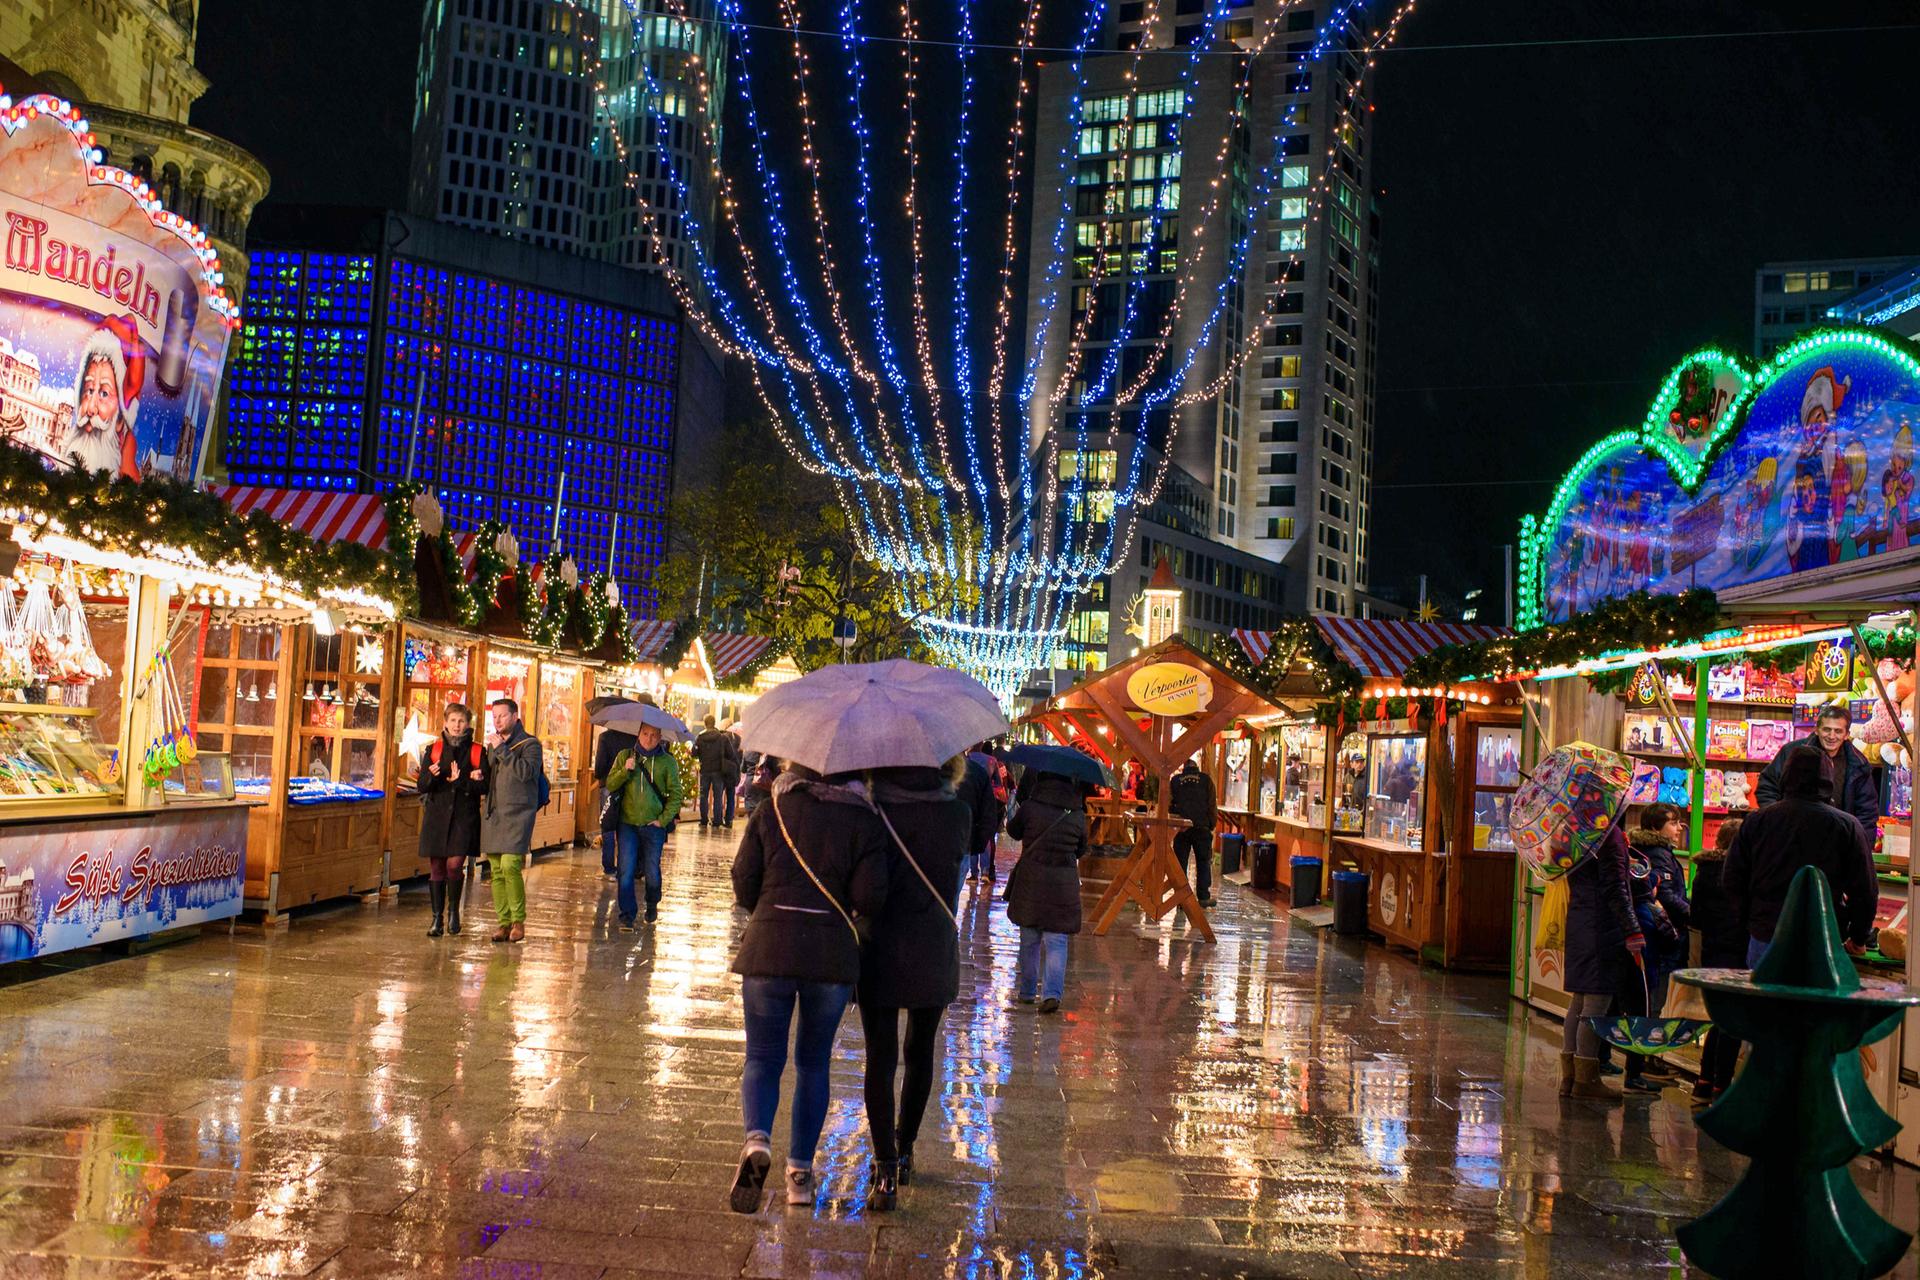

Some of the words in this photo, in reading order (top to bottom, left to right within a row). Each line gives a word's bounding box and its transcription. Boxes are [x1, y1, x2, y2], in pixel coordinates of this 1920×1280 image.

[4, 210, 162, 328] Mandeln
[1138, 673, 1198, 699] Verpoorten
[1806, 640, 1830, 685] DARTS
[55, 850, 123, 913] Süße
[122, 844, 240, 904] Spezialitäten
